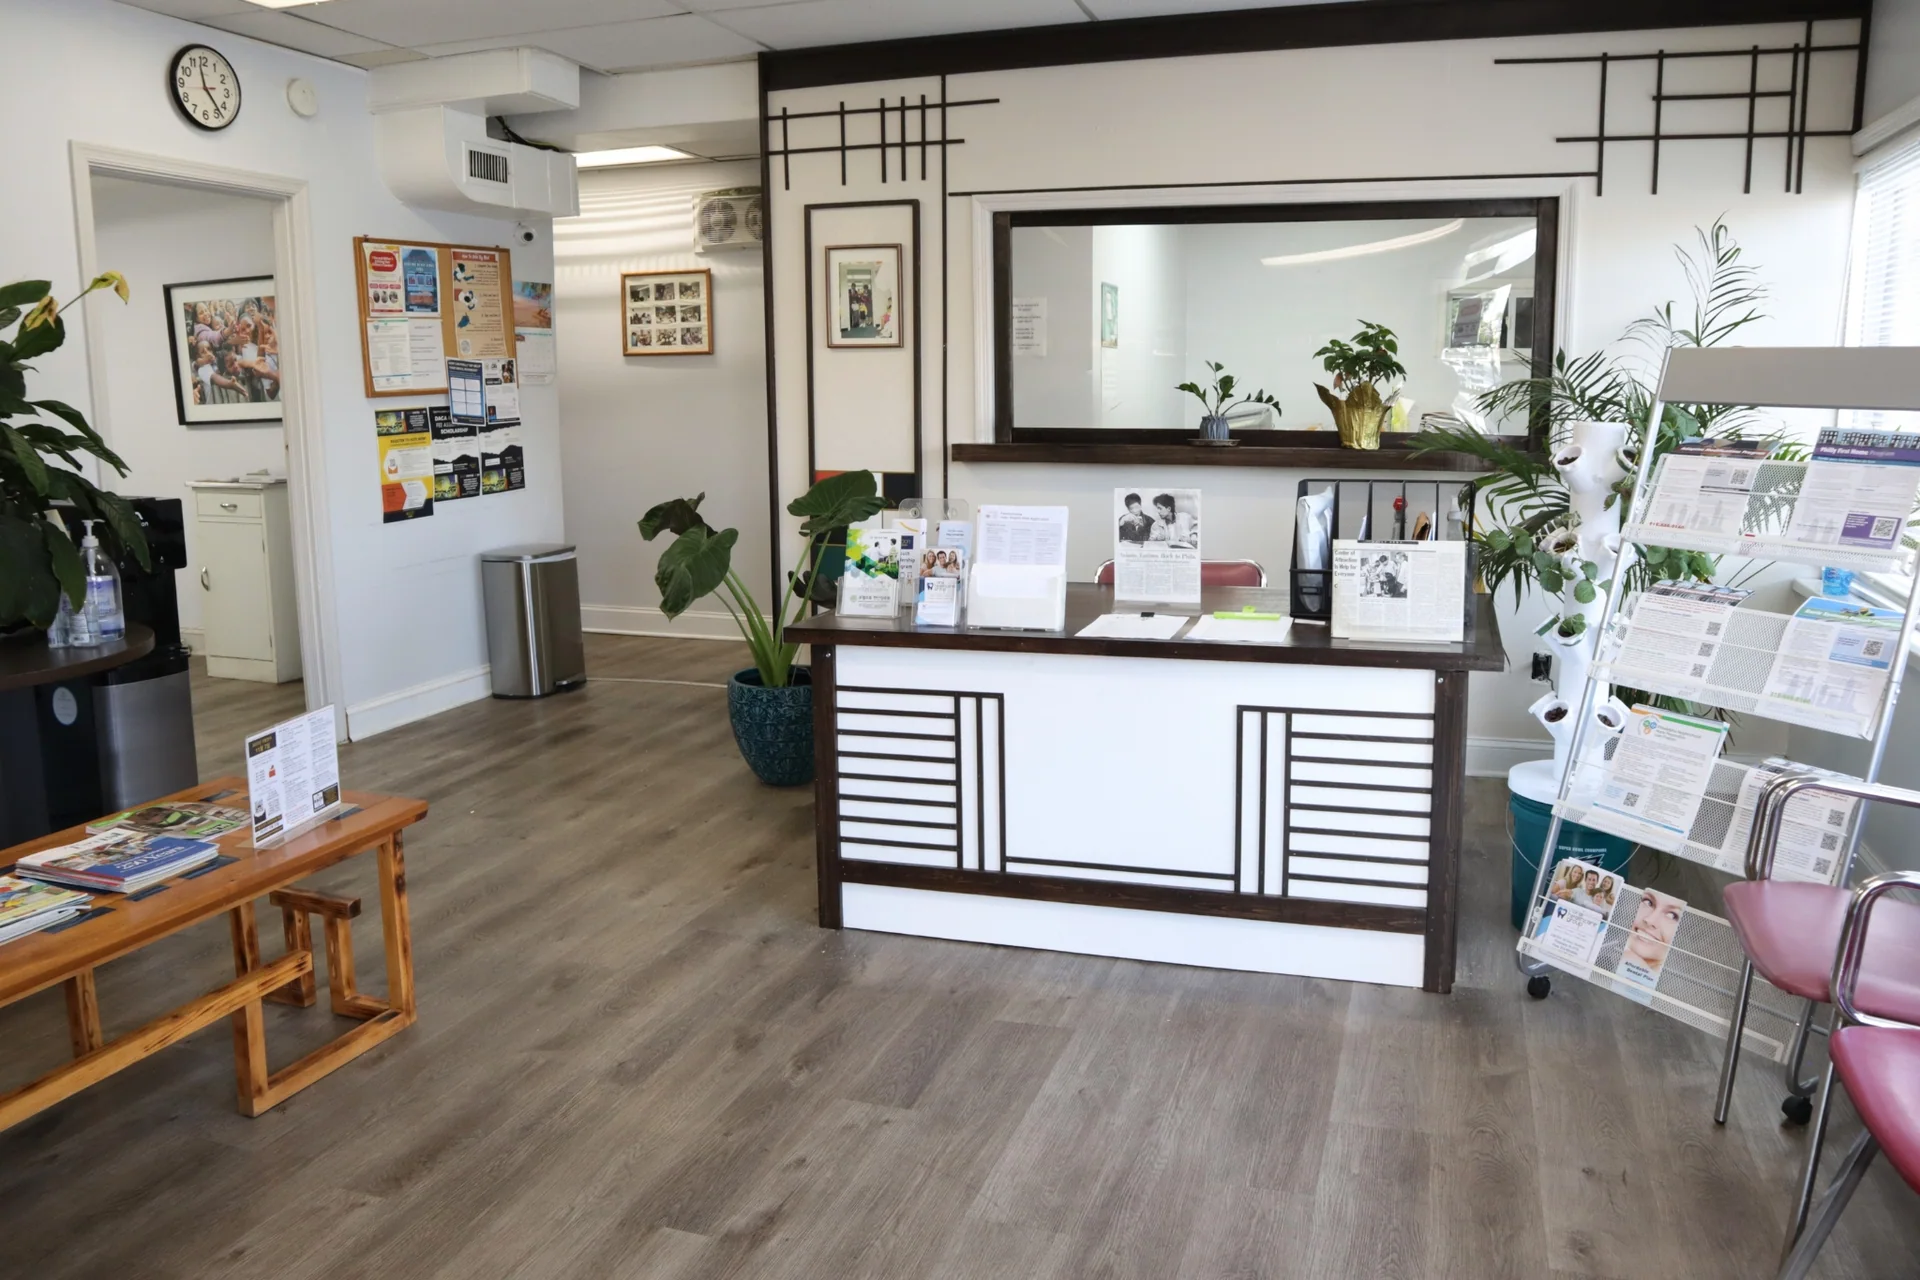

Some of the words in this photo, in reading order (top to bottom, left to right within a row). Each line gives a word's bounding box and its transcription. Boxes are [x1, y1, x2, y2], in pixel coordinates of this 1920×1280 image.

[189, 57, 196, 68] 11
[198, 56, 208, 67] 12
[181, 66, 192, 77] 10
[212, 63, 217, 72] 1
[178, 77, 185, 88] 9
[220, 74, 226, 84] 2
[182, 92, 189, 103] 8
[224, 88, 230, 98] 3
[192, 104, 198, 114] 7
[220, 101, 227, 111] 4
[202, 110, 209, 120] 6
[213, 109, 220, 119] 5
[1625, 962, 1649, 973] Affordable
[1627, 968, 1642, 976] Dental
